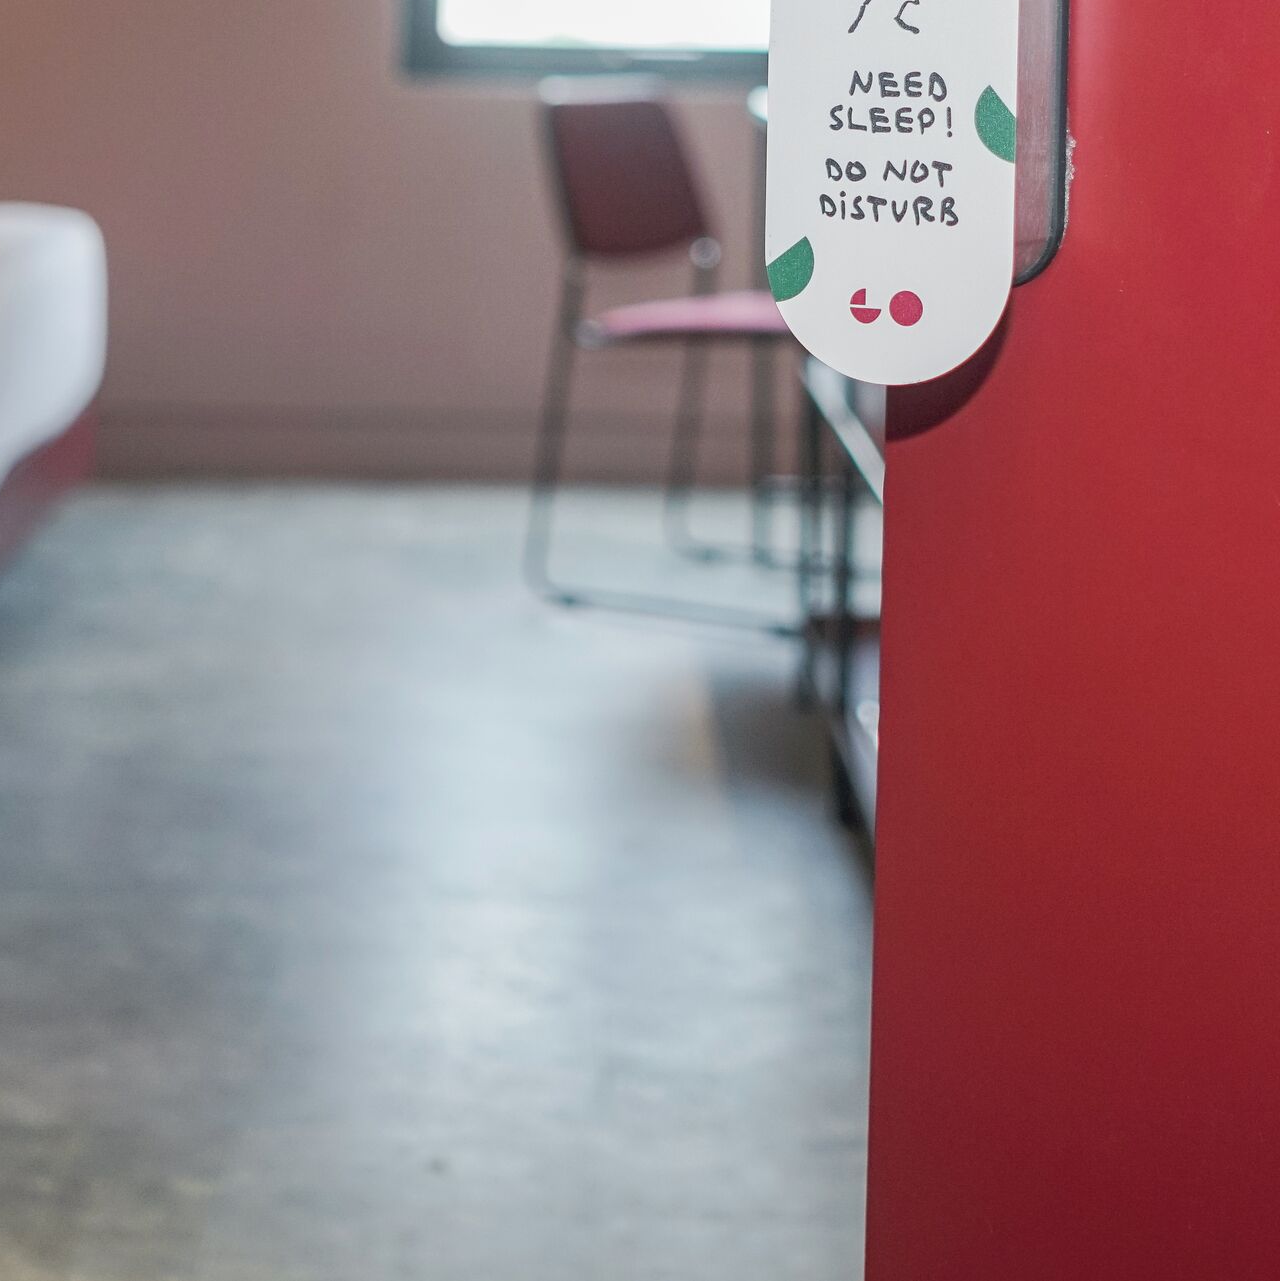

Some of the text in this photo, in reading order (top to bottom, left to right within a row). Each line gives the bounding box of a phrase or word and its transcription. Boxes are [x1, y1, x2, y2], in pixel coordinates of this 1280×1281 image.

[848, 70, 948, 102] NEED
[828, 104, 953, 138] SLEEP!
[825, 157, 953, 188] DO NOT
